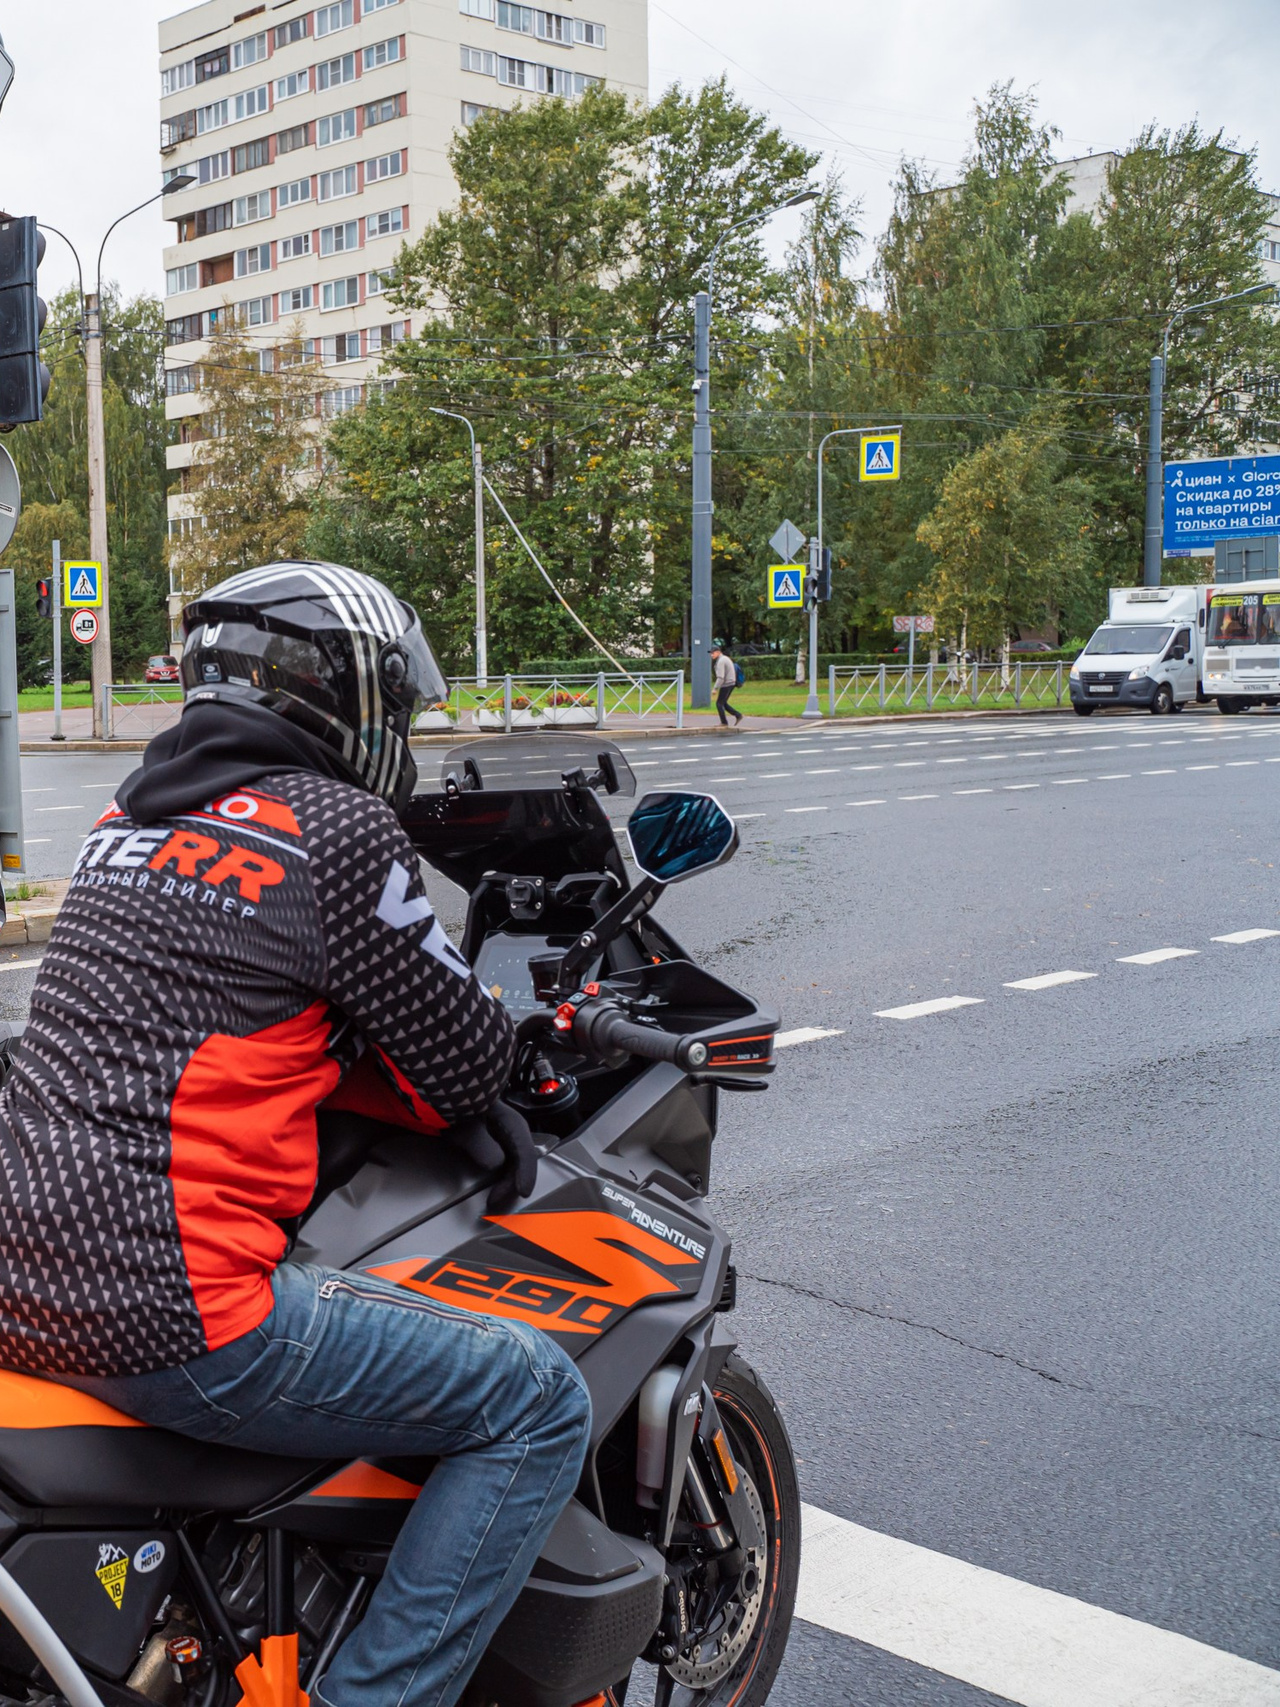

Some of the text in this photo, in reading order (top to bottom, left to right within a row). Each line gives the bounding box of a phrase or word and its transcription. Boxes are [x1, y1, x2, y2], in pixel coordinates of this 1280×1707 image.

[1185, 475, 1222, 488] циан
[1175, 490, 1230, 503] Скидка
[1233, 488, 1252, 500] до
[1176, 501, 1272, 516] на квартиры
[1175, 518, 1227, 530] только
[1230, 516, 1249, 527] на
[1243, 595, 1259, 606] 205
[160, 878, 256, 920] ДИЛЕР
[602, 1186, 636, 1209] SUPER
[631, 1208, 706, 1260] ADVENTURE
[409, 1259, 628, 1326] 1290
[141, 1551, 161, 1570] MOTO
[99, 1561, 128, 1581] PROJECT
[111, 1583, 122, 1599] 18
